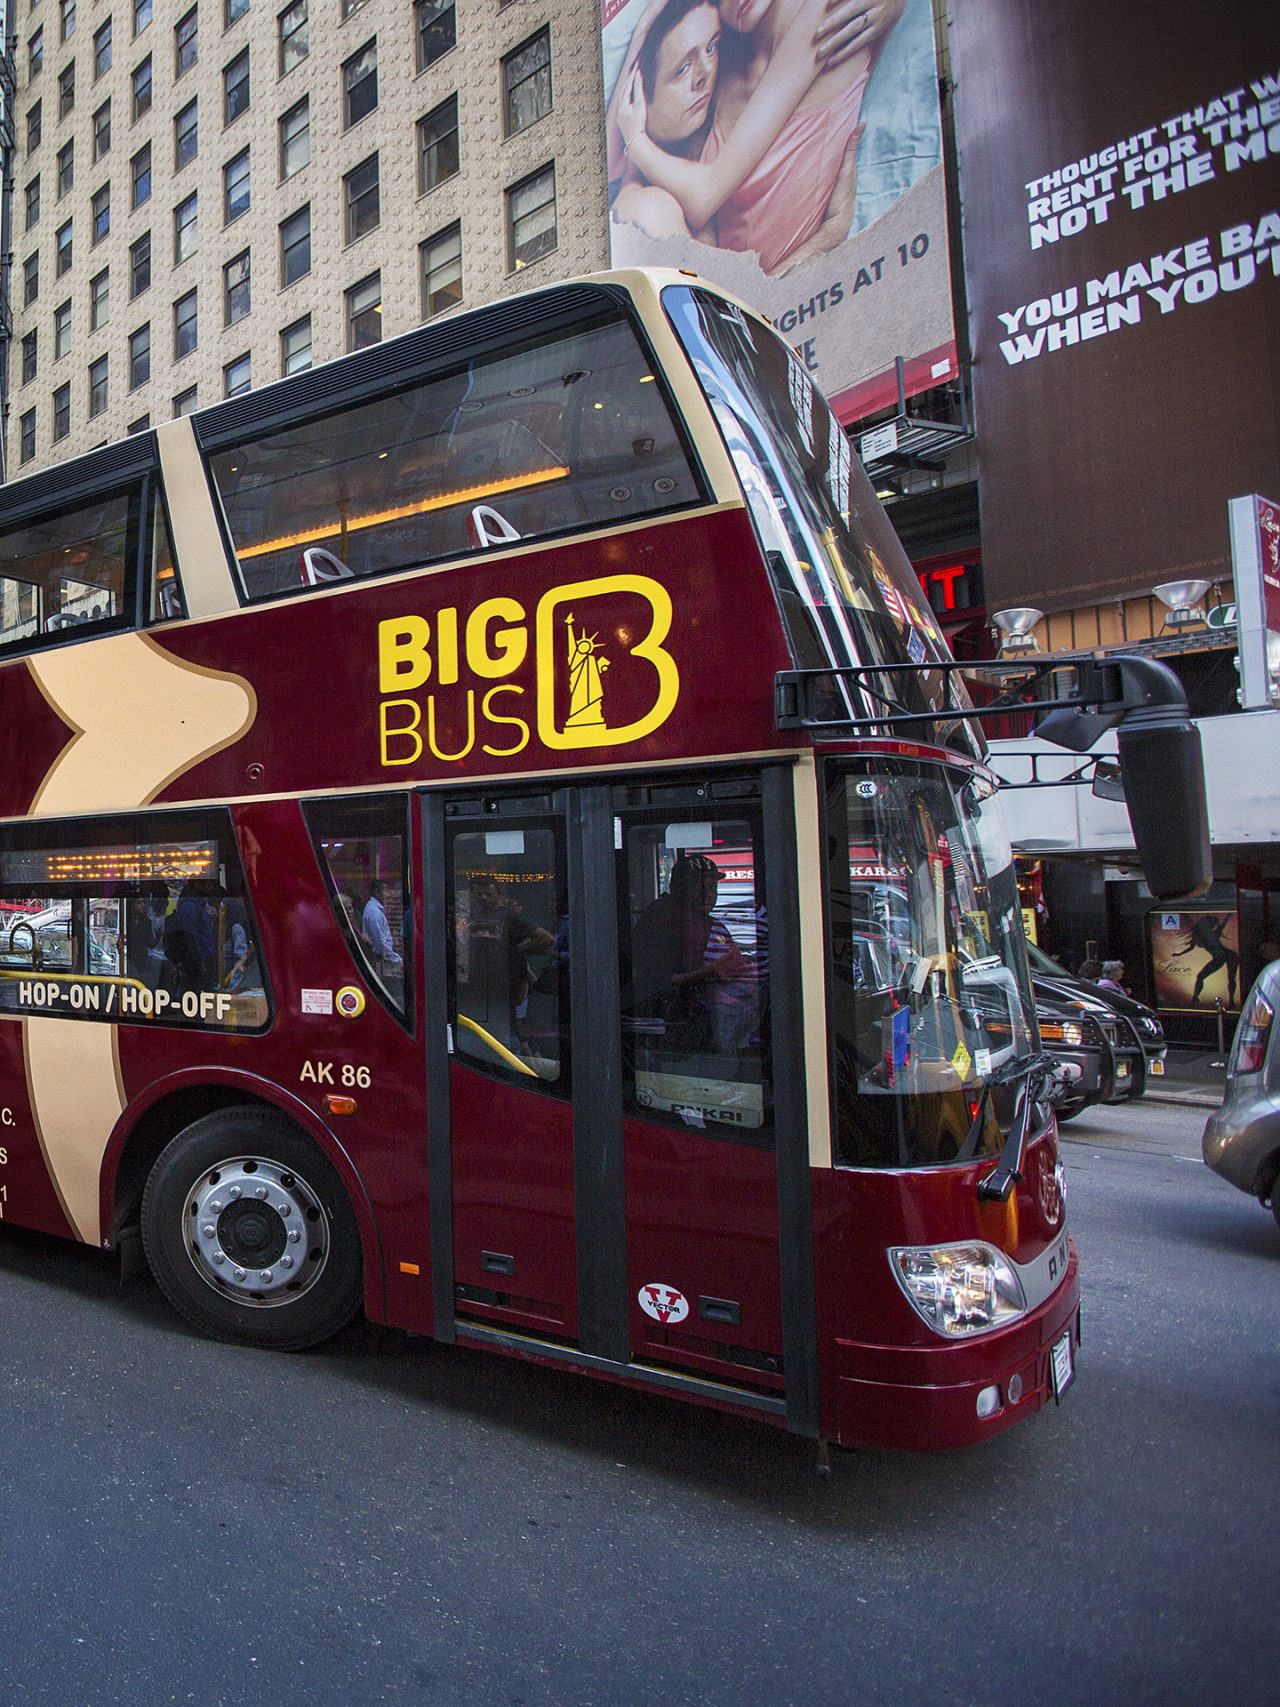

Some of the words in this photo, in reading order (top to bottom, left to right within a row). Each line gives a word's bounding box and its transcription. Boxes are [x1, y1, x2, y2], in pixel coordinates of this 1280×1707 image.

[1025, 127, 1157, 198] THOUGHT
[1161, 89, 1246, 138] THAT
[1027, 166, 1118, 223] RENT
[1124, 134, 1197, 182] FOR
[1030, 192, 1115, 250] NOT
[1122, 151, 1215, 209] THE
[772, 282, 844, 333] IGHTS
[851, 256, 885, 295] AT
[897, 233, 929, 267] 10
[997, 286, 1078, 334] YOU
[1086, 237, 1213, 306] MAKE
[1220, 212, 1280, 258] BA
[999, 294, 1141, 366] WHEN
[378, 597, 528, 693] BIG
[379, 684, 530, 766] BUS
[724, 870, 754, 880] RES
[20, 981, 99, 1010] HOP-ON
[122, 987, 232, 1020] HOP-OFF
[300, 1060, 335, 1085] AK
[341, 1064, 372, 1089] 86
[648, 1300, 680, 1313] VECTOR
